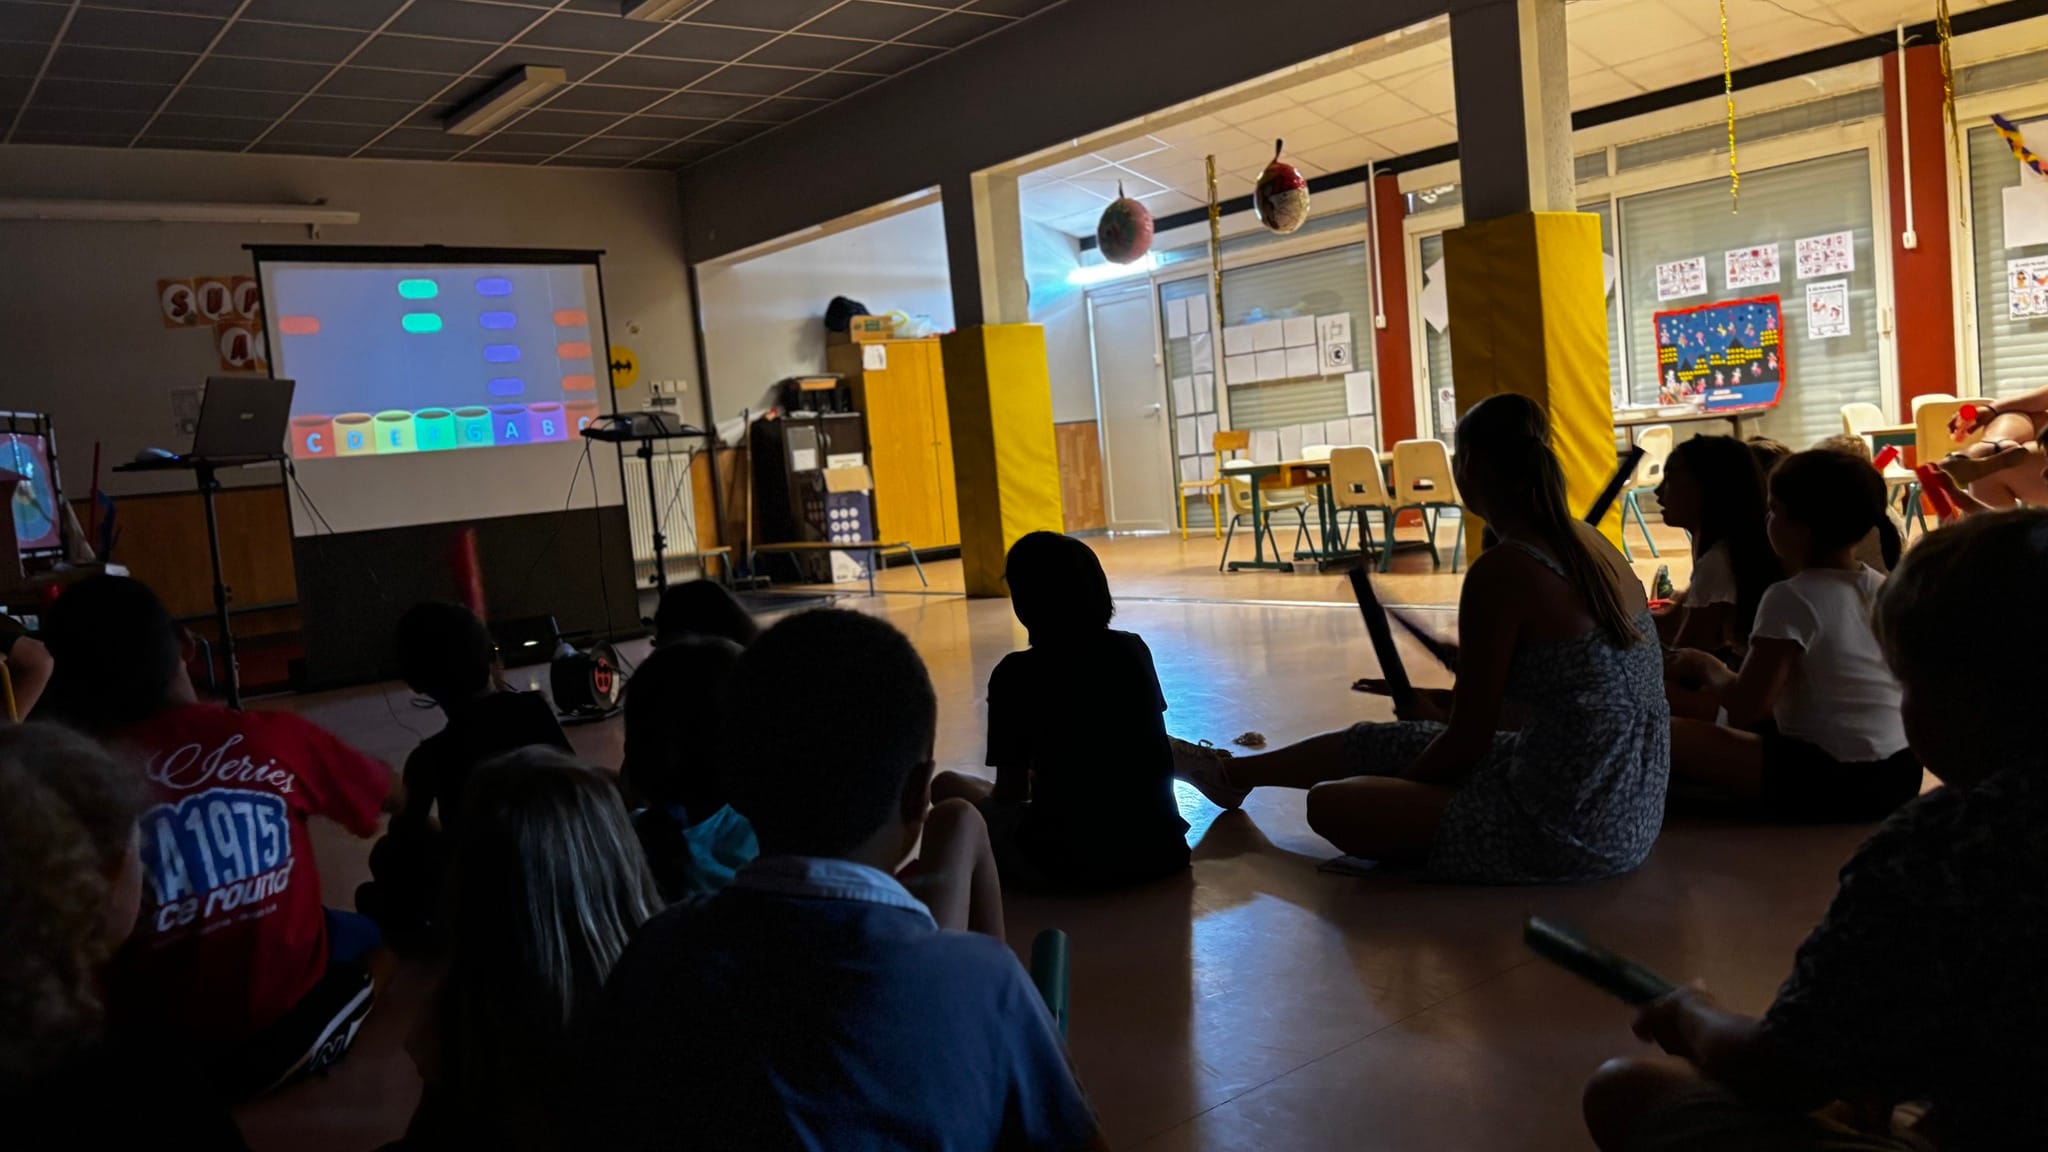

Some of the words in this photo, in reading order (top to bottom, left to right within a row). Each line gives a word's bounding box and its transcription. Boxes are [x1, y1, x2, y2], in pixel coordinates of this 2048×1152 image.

[306, 432, 323, 454] C
[346, 430, 364, 450] D
[389, 427, 403, 448] E
[466, 423, 482, 441] G
[505, 421, 519, 439] A
[541, 419, 555, 437] B
[147, 733, 296, 793] Series
[151, 816, 194, 906] A
[184, 799, 280, 889] 1975
[155, 896, 200, 933] ce
[203, 856, 296, 919] round
